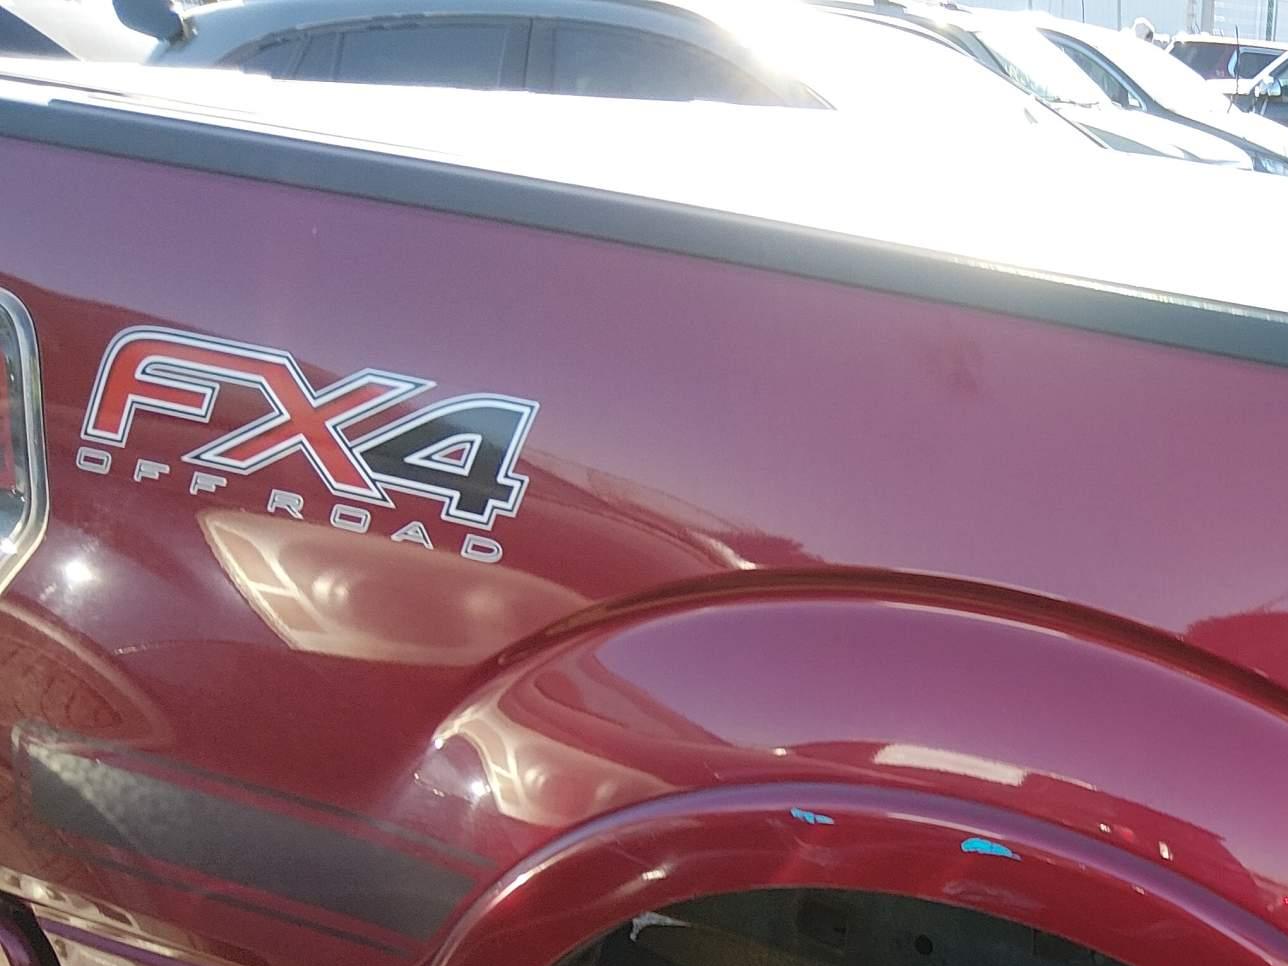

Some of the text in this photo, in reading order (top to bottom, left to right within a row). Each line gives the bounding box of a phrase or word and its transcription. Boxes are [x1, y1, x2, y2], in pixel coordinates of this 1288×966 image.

[76, 446, 503, 564] OFF ROAD
[80, 325, 540, 530] FX4
